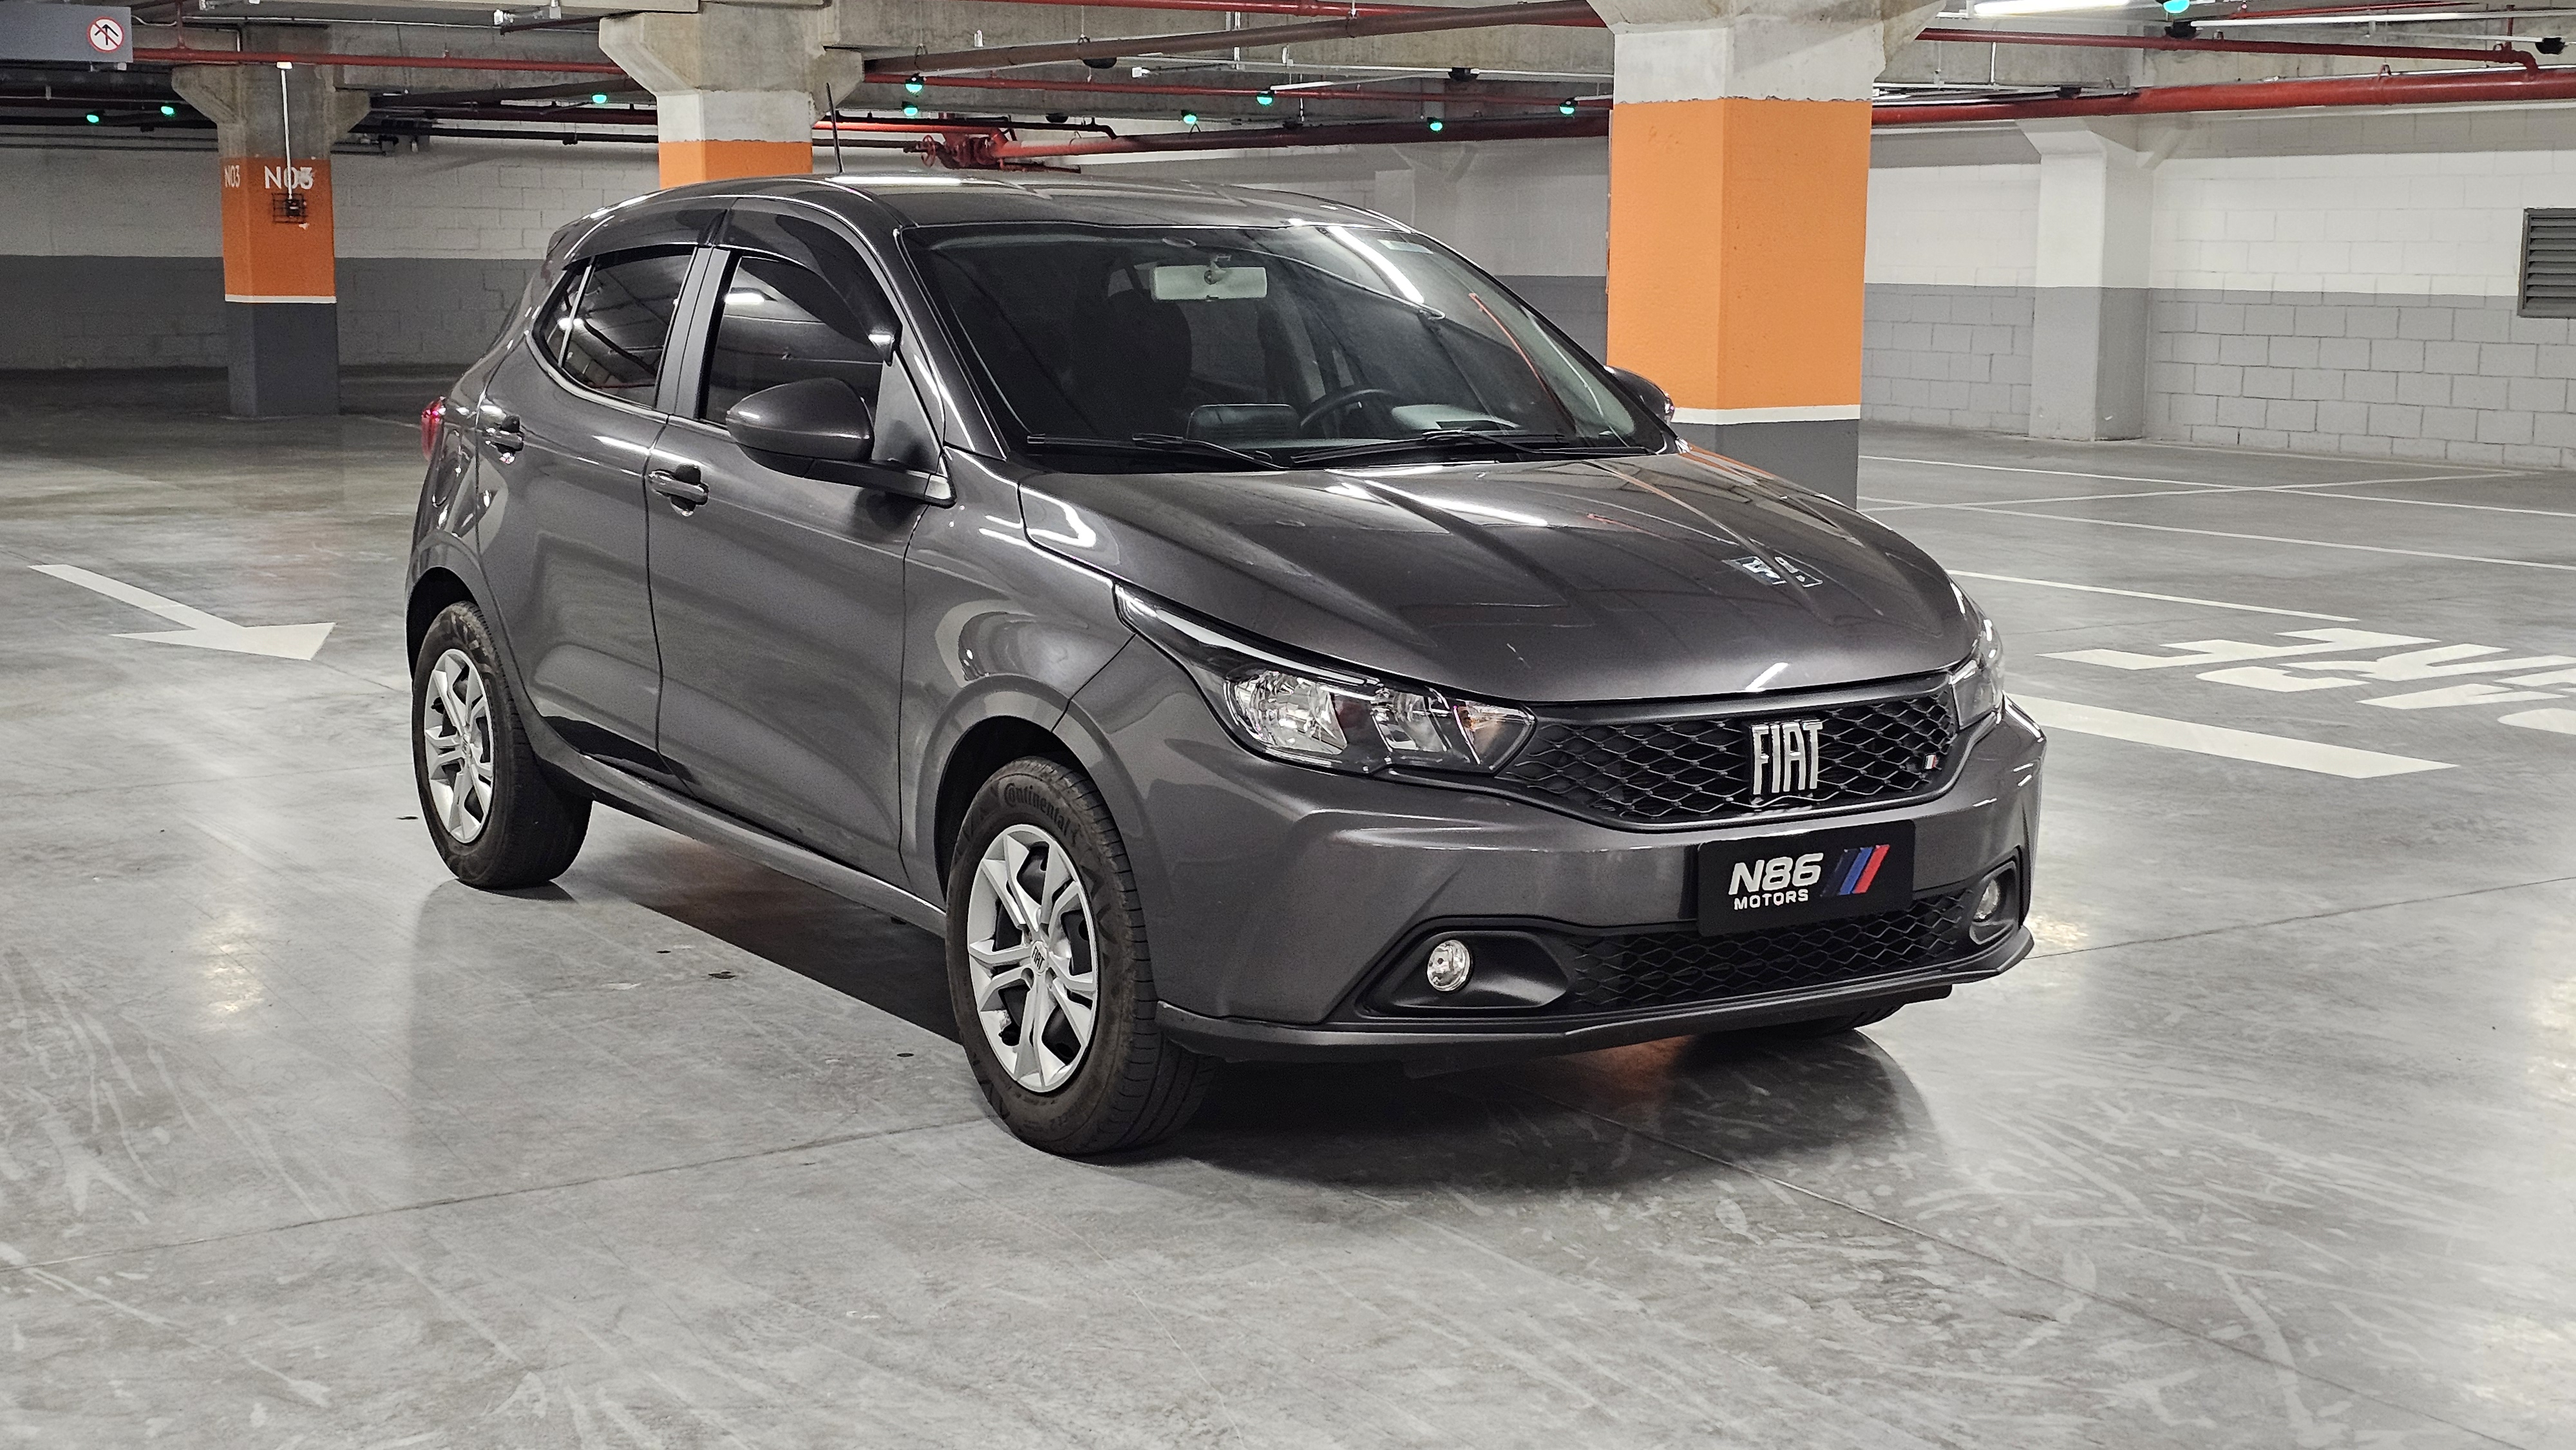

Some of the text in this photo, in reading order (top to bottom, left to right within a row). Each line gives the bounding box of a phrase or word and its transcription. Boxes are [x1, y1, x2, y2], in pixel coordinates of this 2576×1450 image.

[1752, 720, 1823, 795] FIAT
[1003, 782, 1071, 836] Continental
[1728, 852, 1824, 896] N86
[1734, 888, 1808, 910] MOTORS
[1032, 945, 1045, 970] FIAT
